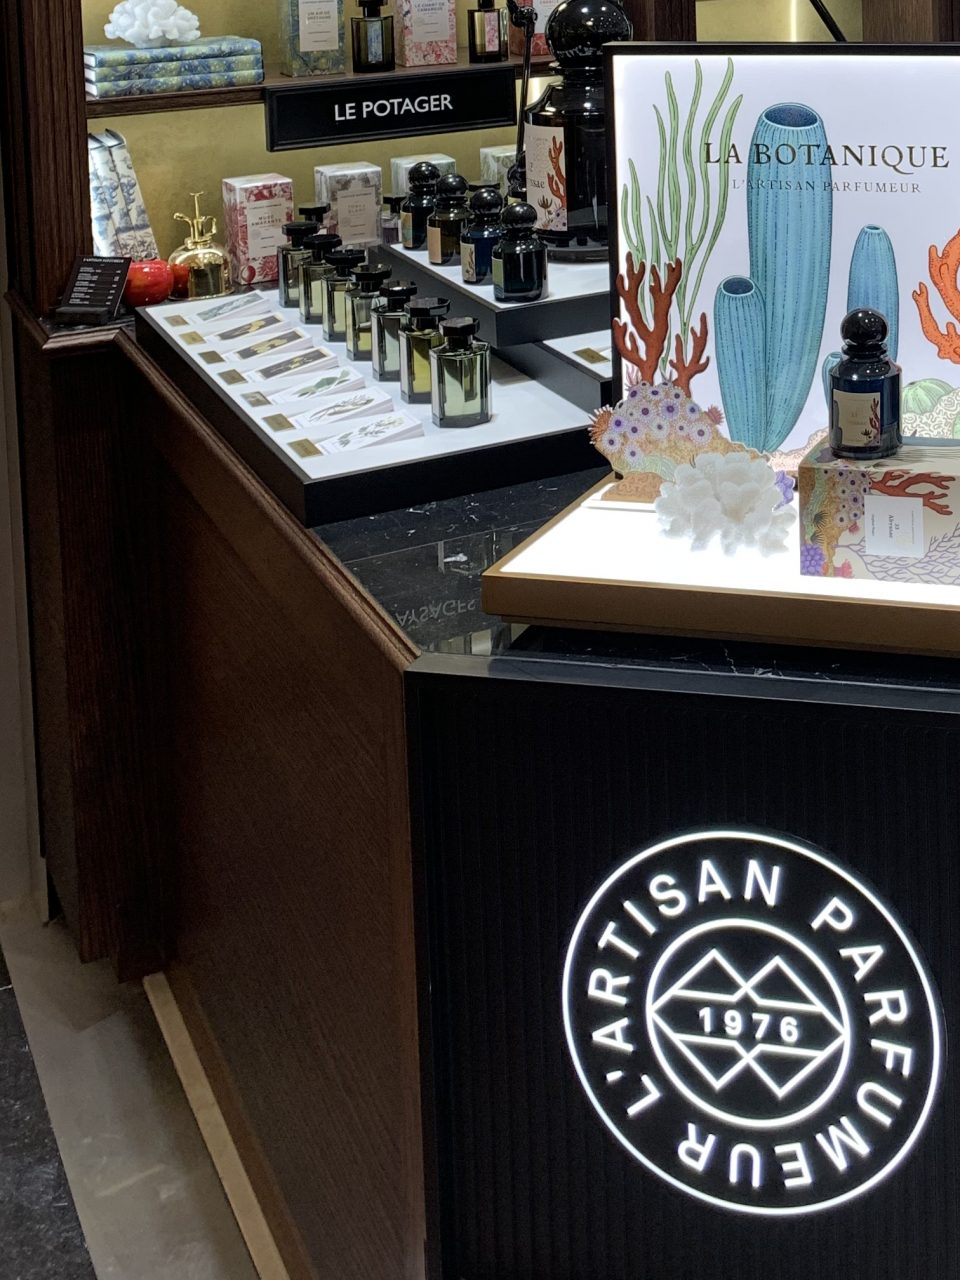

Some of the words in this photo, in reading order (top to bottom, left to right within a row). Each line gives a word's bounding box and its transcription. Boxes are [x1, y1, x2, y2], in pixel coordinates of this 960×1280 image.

[334, 102, 356, 121] LE
[362, 94, 453, 118] POTAGER
[703, 142, 743, 165] LA
[753, 143, 950, 175] BOTANIQUE
[732, 179, 816, 192] L'ARTISAN
[823, 179, 922, 194] PARFUMEUR
[587, 858, 781, 1117] L'ARTISAN
[676, 896, 913, 1188] PARFUMEUR
[698, 1006, 799, 1043] 1976
